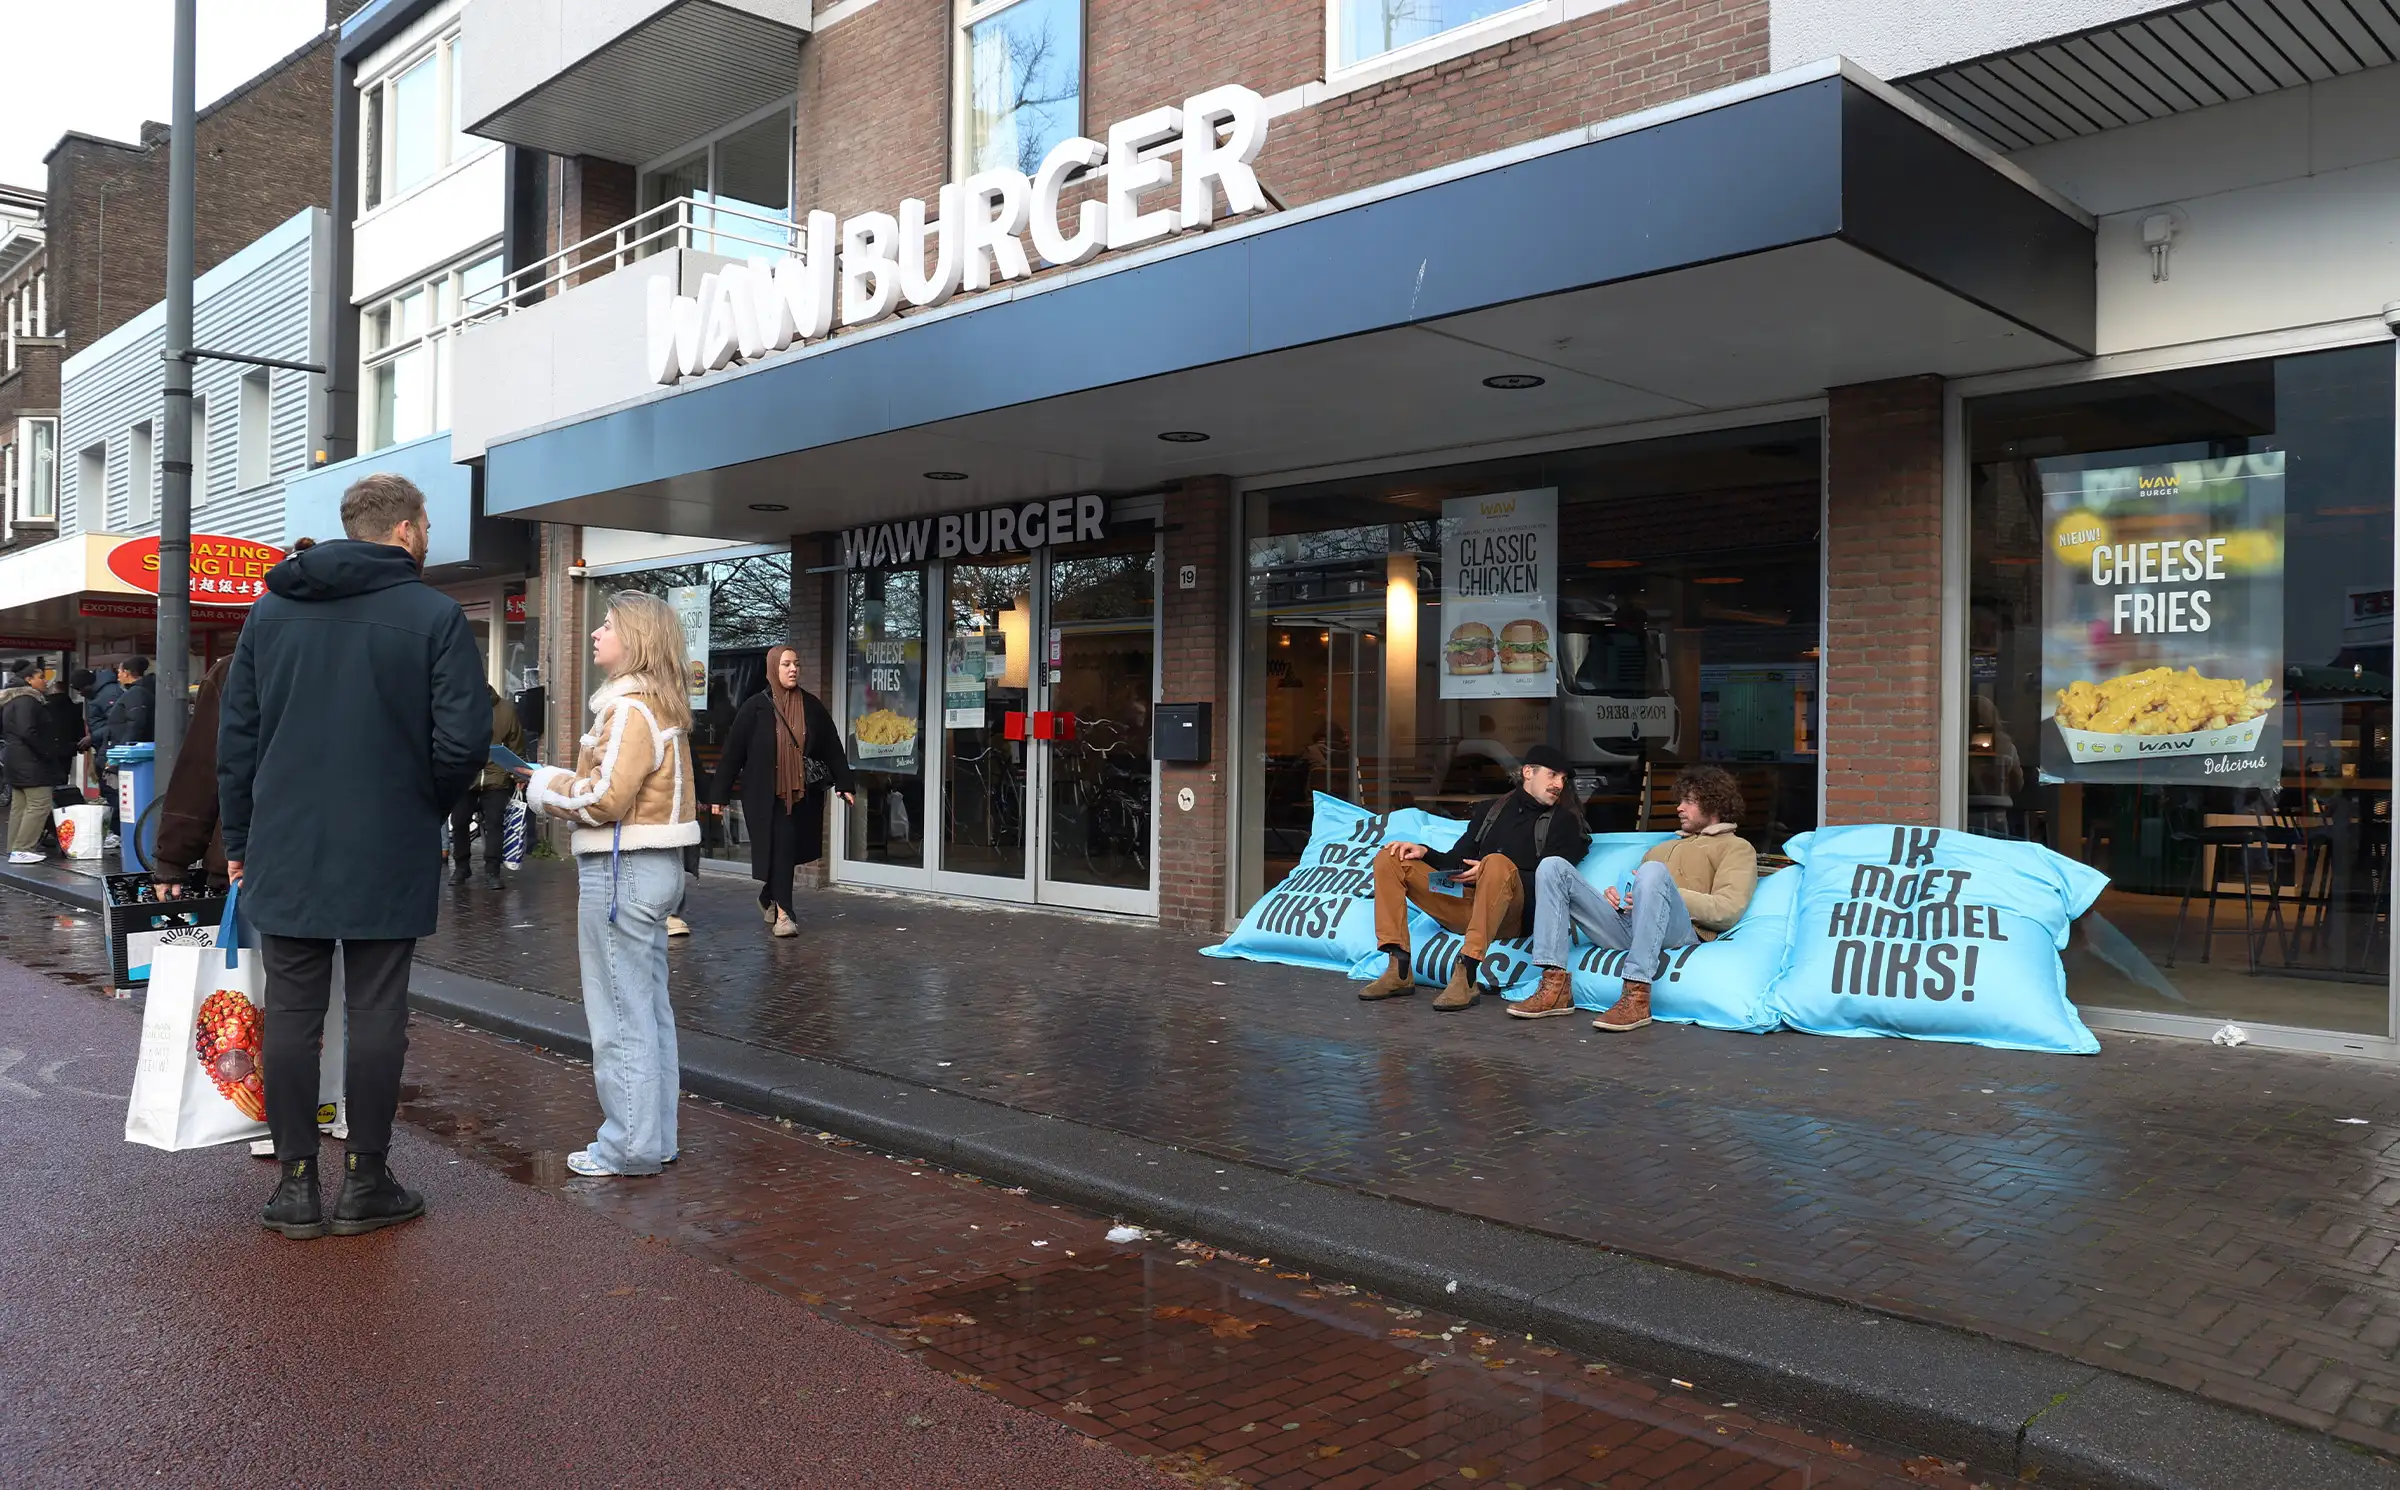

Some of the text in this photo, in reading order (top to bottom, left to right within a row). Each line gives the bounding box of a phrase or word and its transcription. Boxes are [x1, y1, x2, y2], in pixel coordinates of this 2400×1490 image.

[646, 84, 1268, 385] WAW BURGER
[2139, 473, 2181, 489] WAW
[2140, 488, 2180, 498] BURGER
[1480, 499, 1516, 516] WAW
[841, 494, 1105, 569] WAW BURGER
[2058, 527, 2102, 547] NIEUW!
[157, 542, 271, 560] AZING
[1460, 532, 1537, 567] CLASSIC
[2092, 537, 2226, 586] CHEESE
[142, 553, 220, 577] SNG
[1180, 571, 1195, 584] 19
[1459, 563, 1538, 597] CHICKEN
[82, 602, 149, 615] EXOTISCHE
[226, 610, 250, 620] TOK
[2113, 590, 2212, 635] FRIES
[865, 642, 905, 664] CHEESE
[871, 668, 901, 692] FRIES
[2139, 738, 2195, 752] WAW
[2203, 754, 2268, 775] Delicious
[1348, 812, 1392, 845] IK
[1888, 826, 1941, 869] IK
[1277, 865, 1376, 900] HIMME
[1850, 863, 1972, 909] MOET
[1256, 892, 1353, 940] NIKS!
[1827, 901, 2009, 942] HIMMEL
[160, 926, 212, 948] ROUWERS
[1831, 939, 1980, 1002] NIKS!
